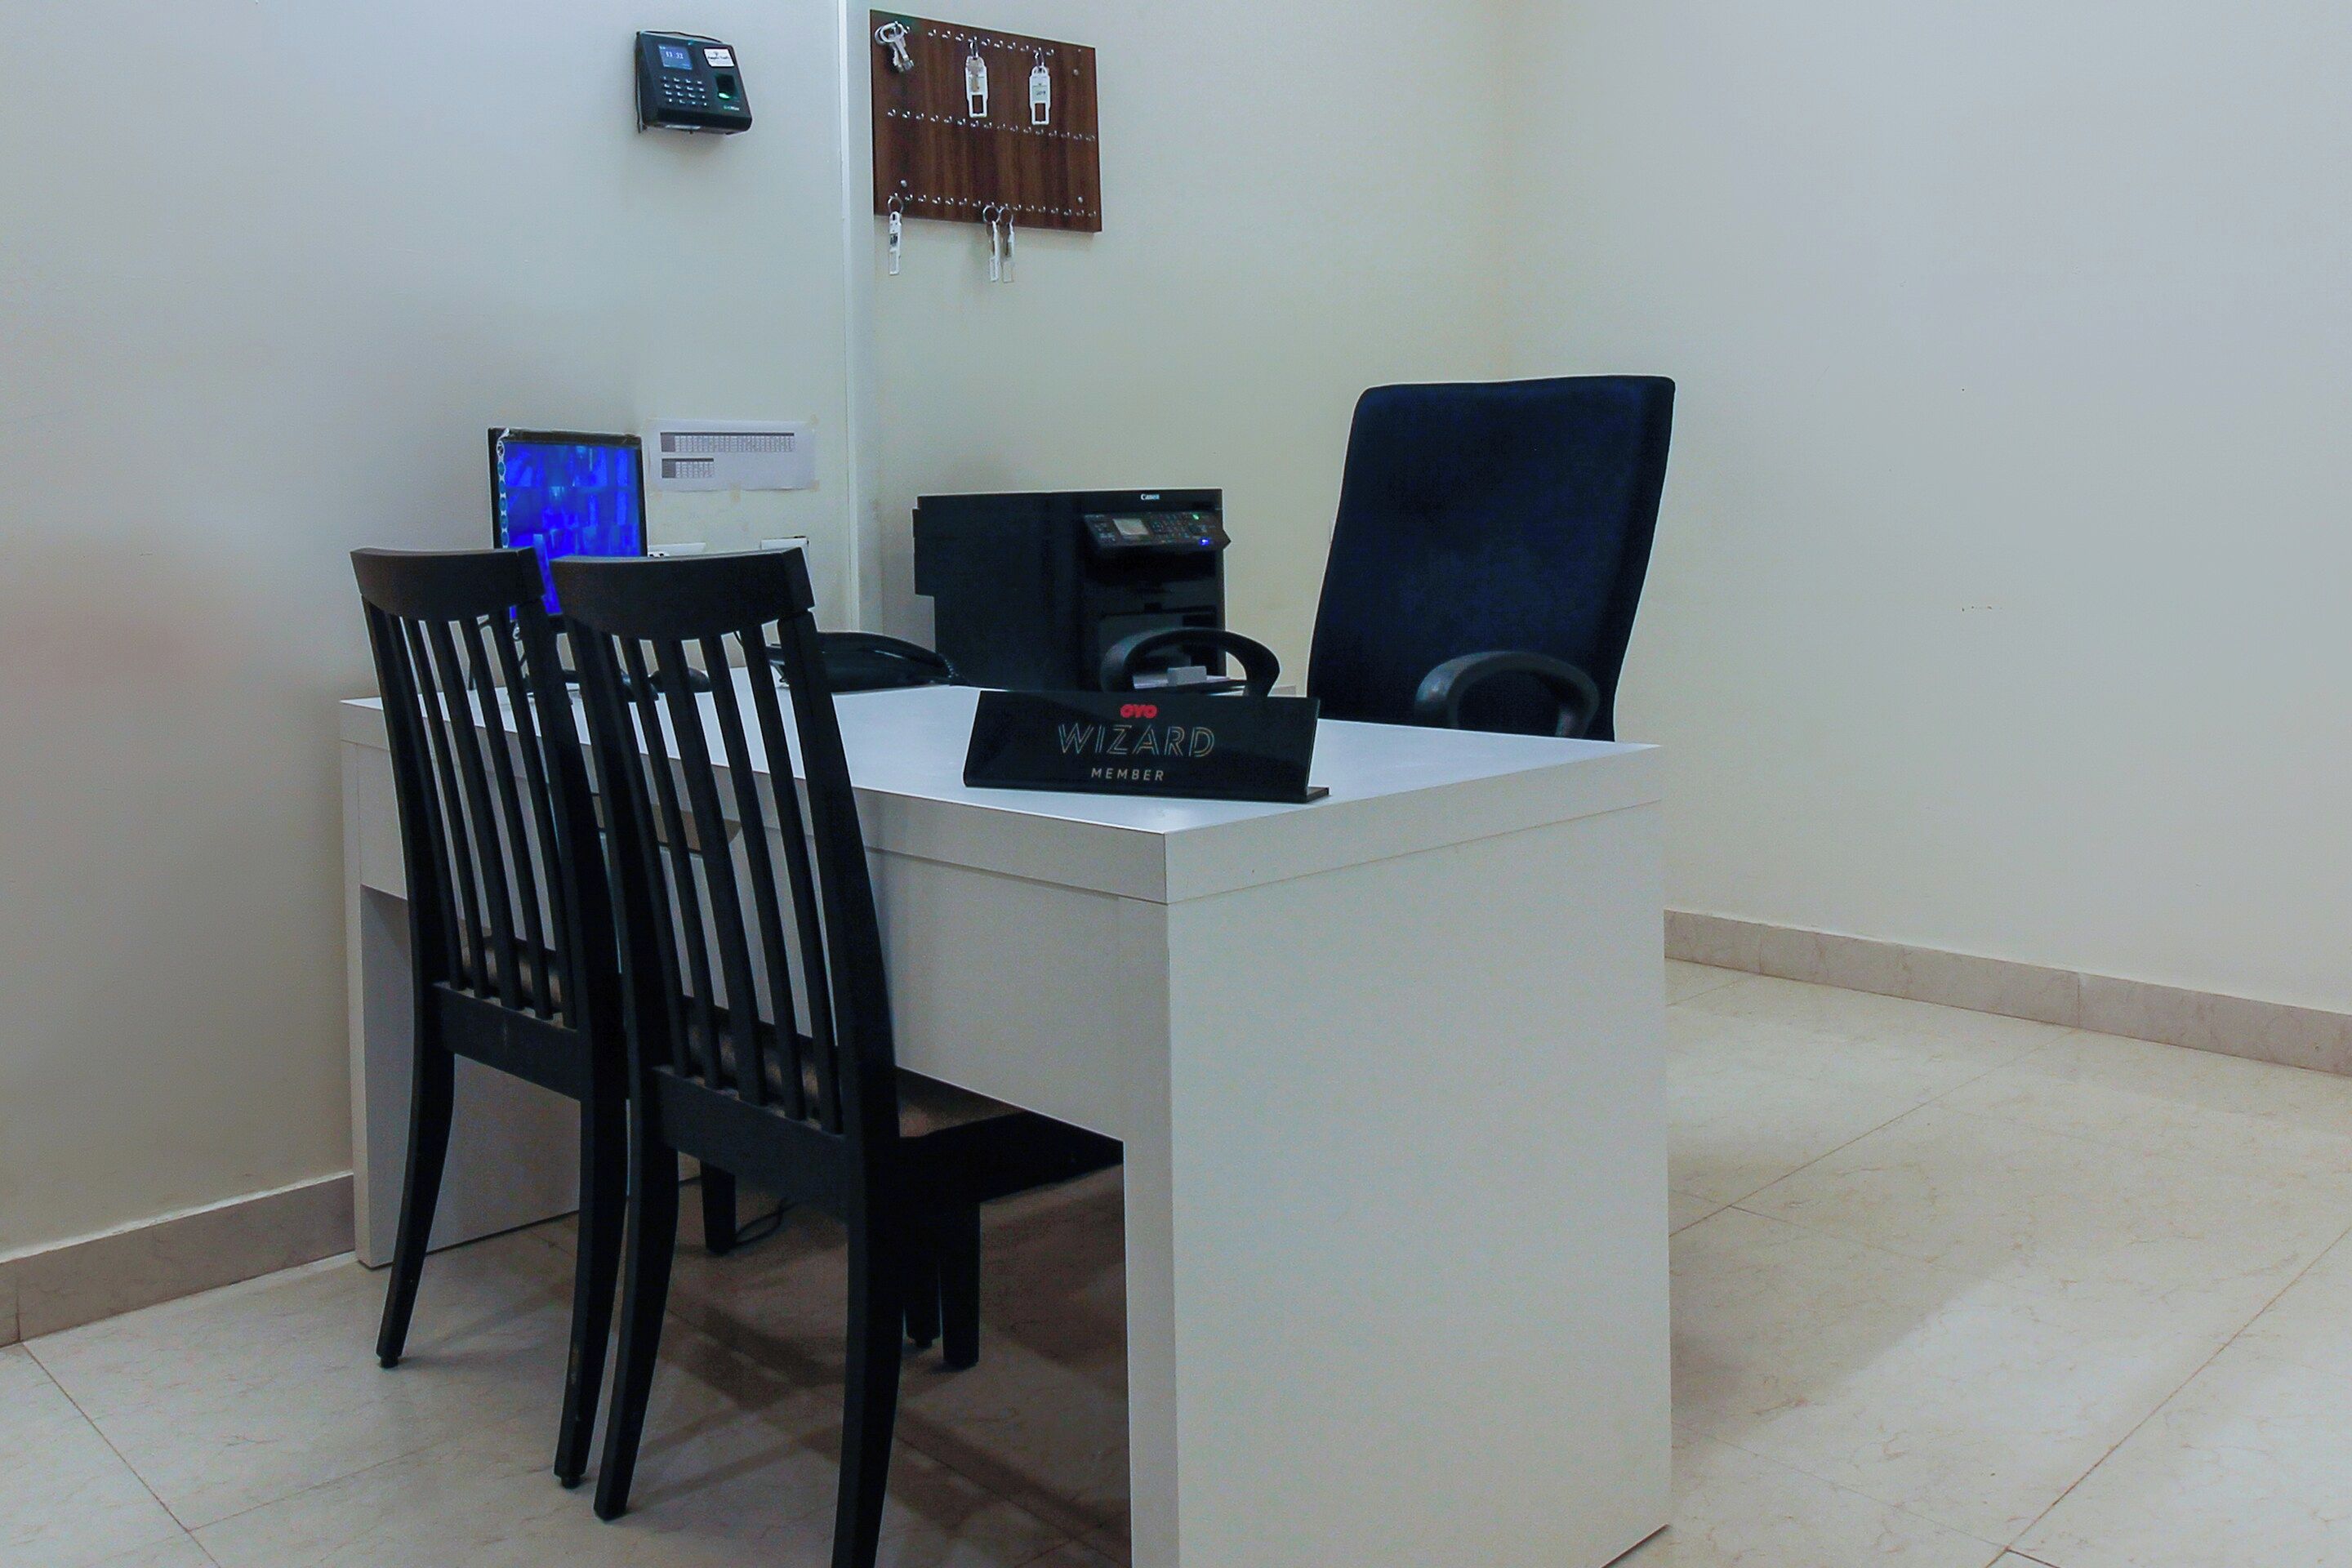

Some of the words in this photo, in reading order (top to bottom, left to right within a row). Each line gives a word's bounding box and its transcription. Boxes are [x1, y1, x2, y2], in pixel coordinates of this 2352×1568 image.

[1120, 704, 1157, 719] OYO
[1058, 723, 1215, 757] WIZARD
[1091, 768, 1165, 782] MEMBER
